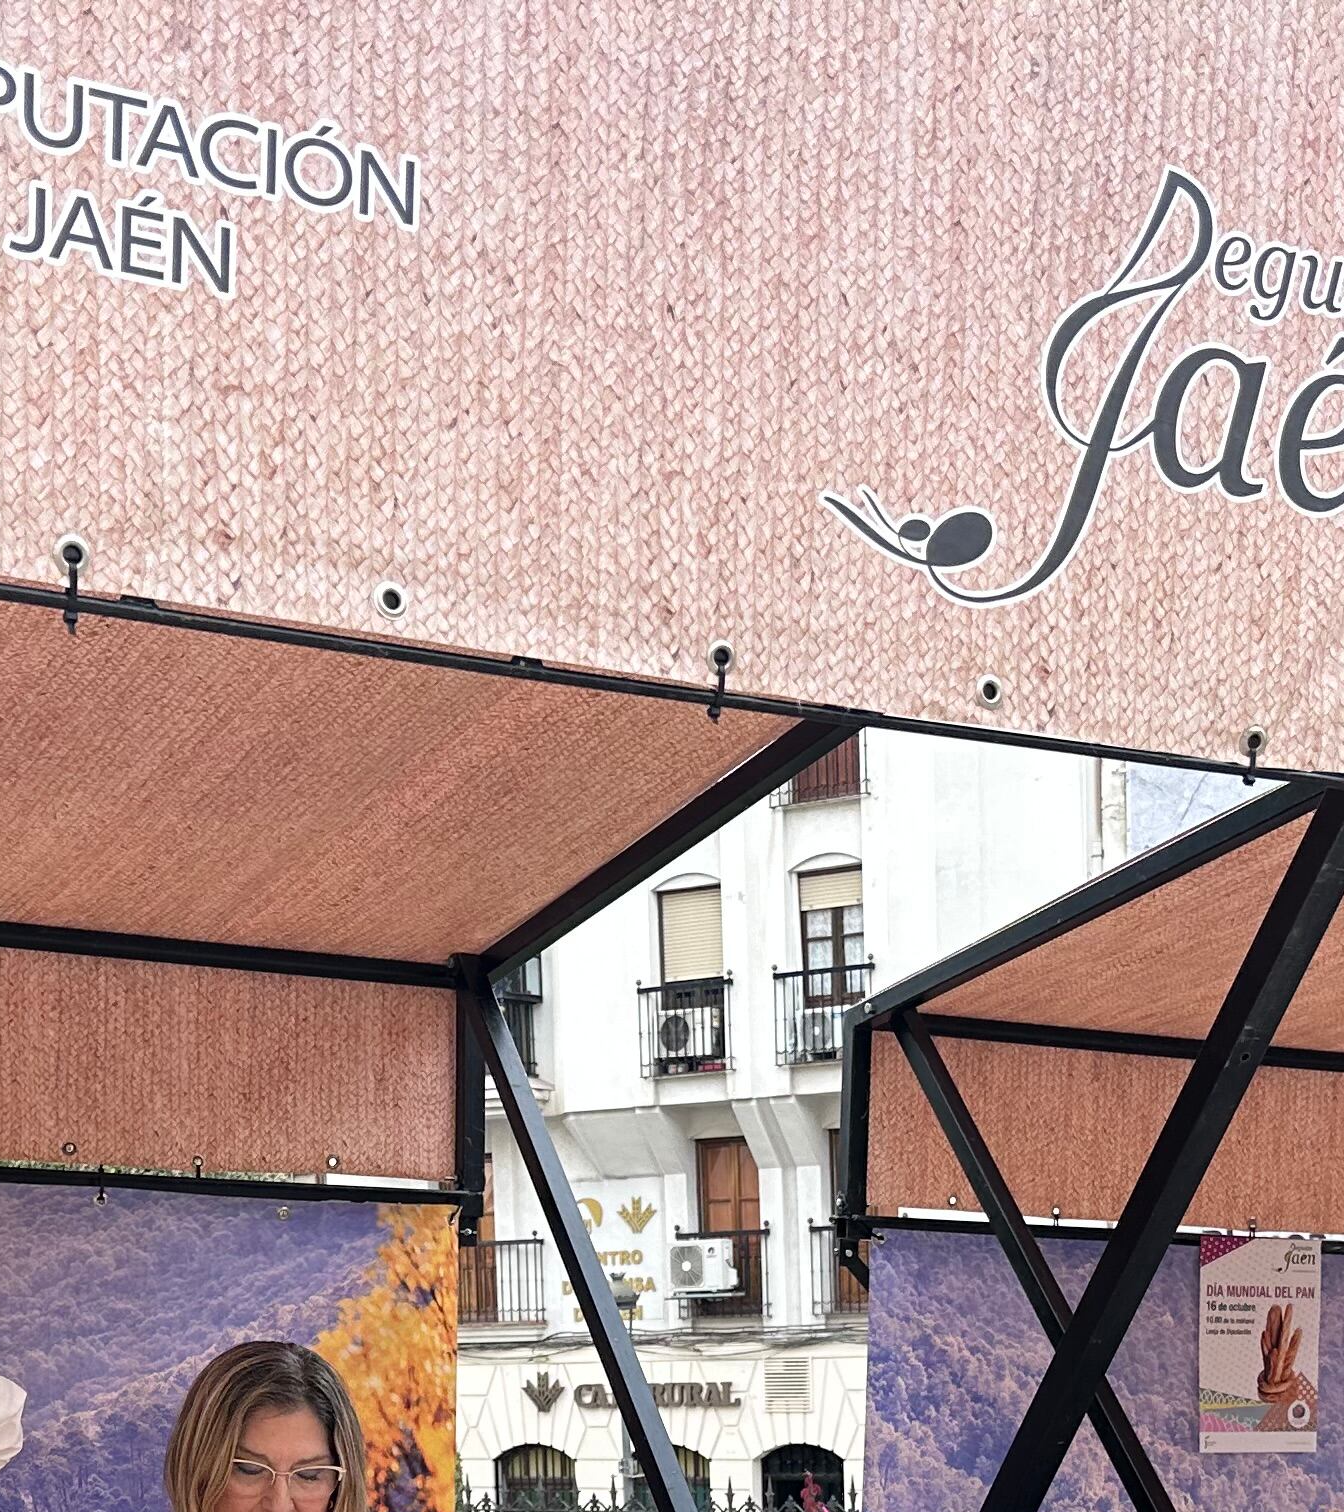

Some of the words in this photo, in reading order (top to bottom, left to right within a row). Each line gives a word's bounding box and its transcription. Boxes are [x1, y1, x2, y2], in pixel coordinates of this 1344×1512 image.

[10, 188, 233, 294] JAÉN
[598, 1249, 643, 1265] NTRO
[1207, 1282, 1224, 1297] DÍA
[1227, 1285, 1272, 1298] MUNDIAL
[1275, 1286, 1293, 1299] DEL
[1296, 1287, 1315, 1299] PAN
[1206, 1301, 1216, 1312] 16
[647, 1381, 742, 1409] RURAL
